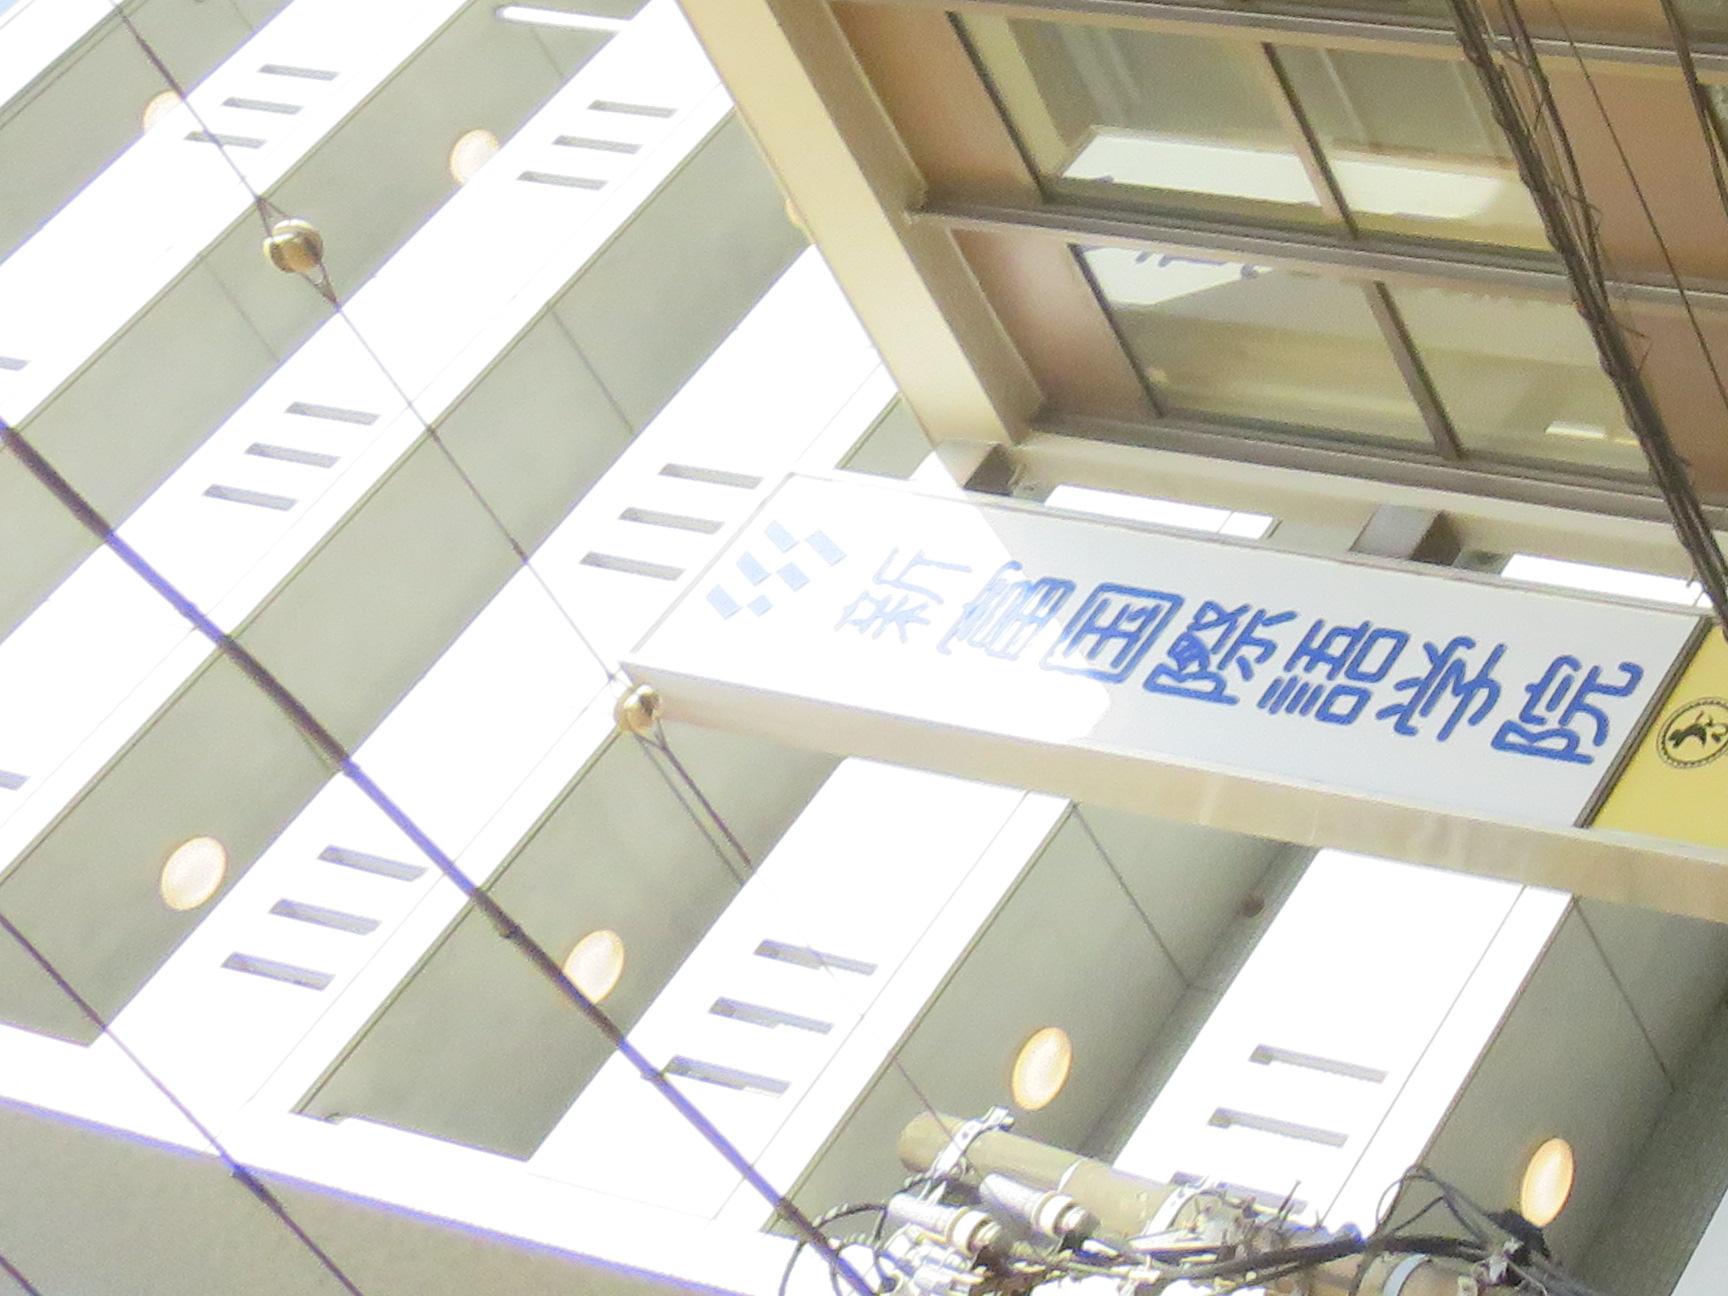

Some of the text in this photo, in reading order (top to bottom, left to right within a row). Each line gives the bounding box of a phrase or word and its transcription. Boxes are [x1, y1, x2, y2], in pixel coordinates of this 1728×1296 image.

[833, 546, 1646, 764] 新富国際語学院
